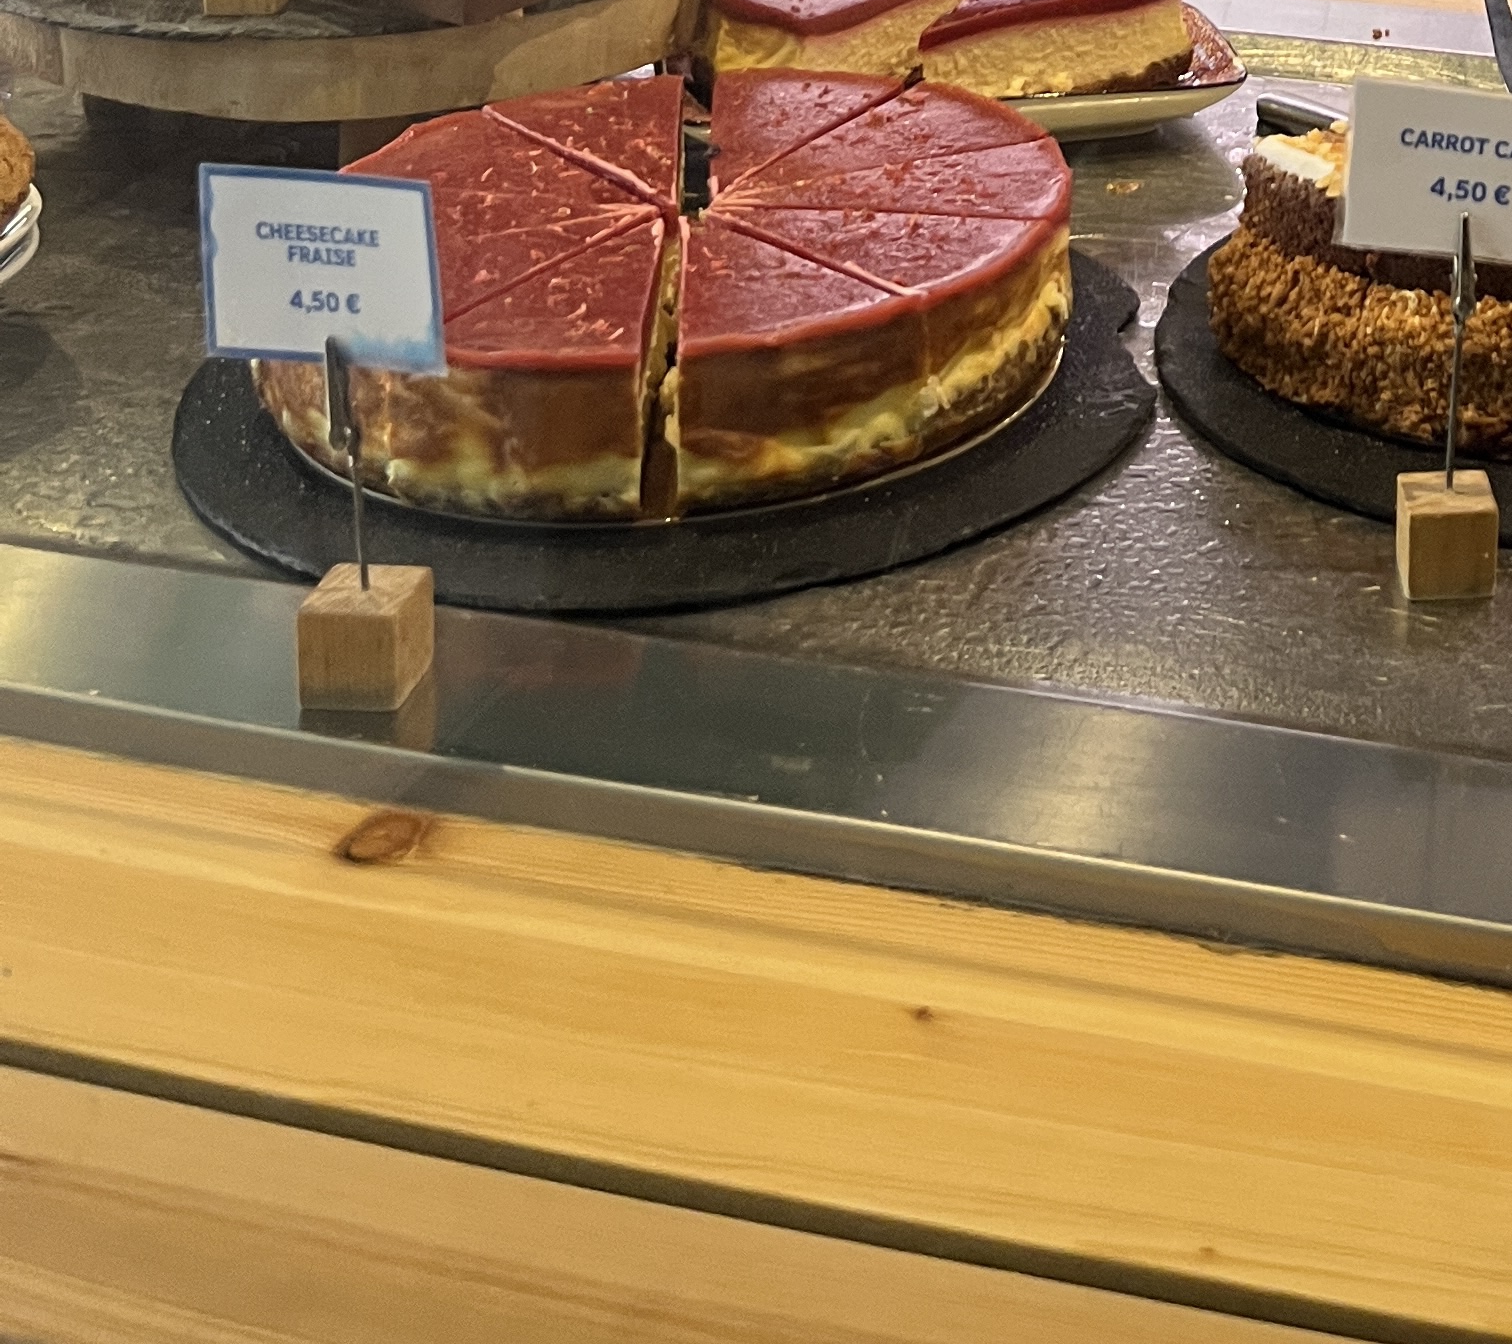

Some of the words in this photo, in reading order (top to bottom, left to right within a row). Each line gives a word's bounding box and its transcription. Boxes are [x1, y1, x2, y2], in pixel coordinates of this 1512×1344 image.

[1400, 127, 1490, 155] CARROT
[1430, 176, 1487, 202] 4,50
[1494, 184, 1511, 205] €
[255, 221, 380, 248] CHEESECAKE
[287, 245, 356, 267] FRAISE
[290, 290, 340, 313] 4,50
[346, 293, 361, 315] €
